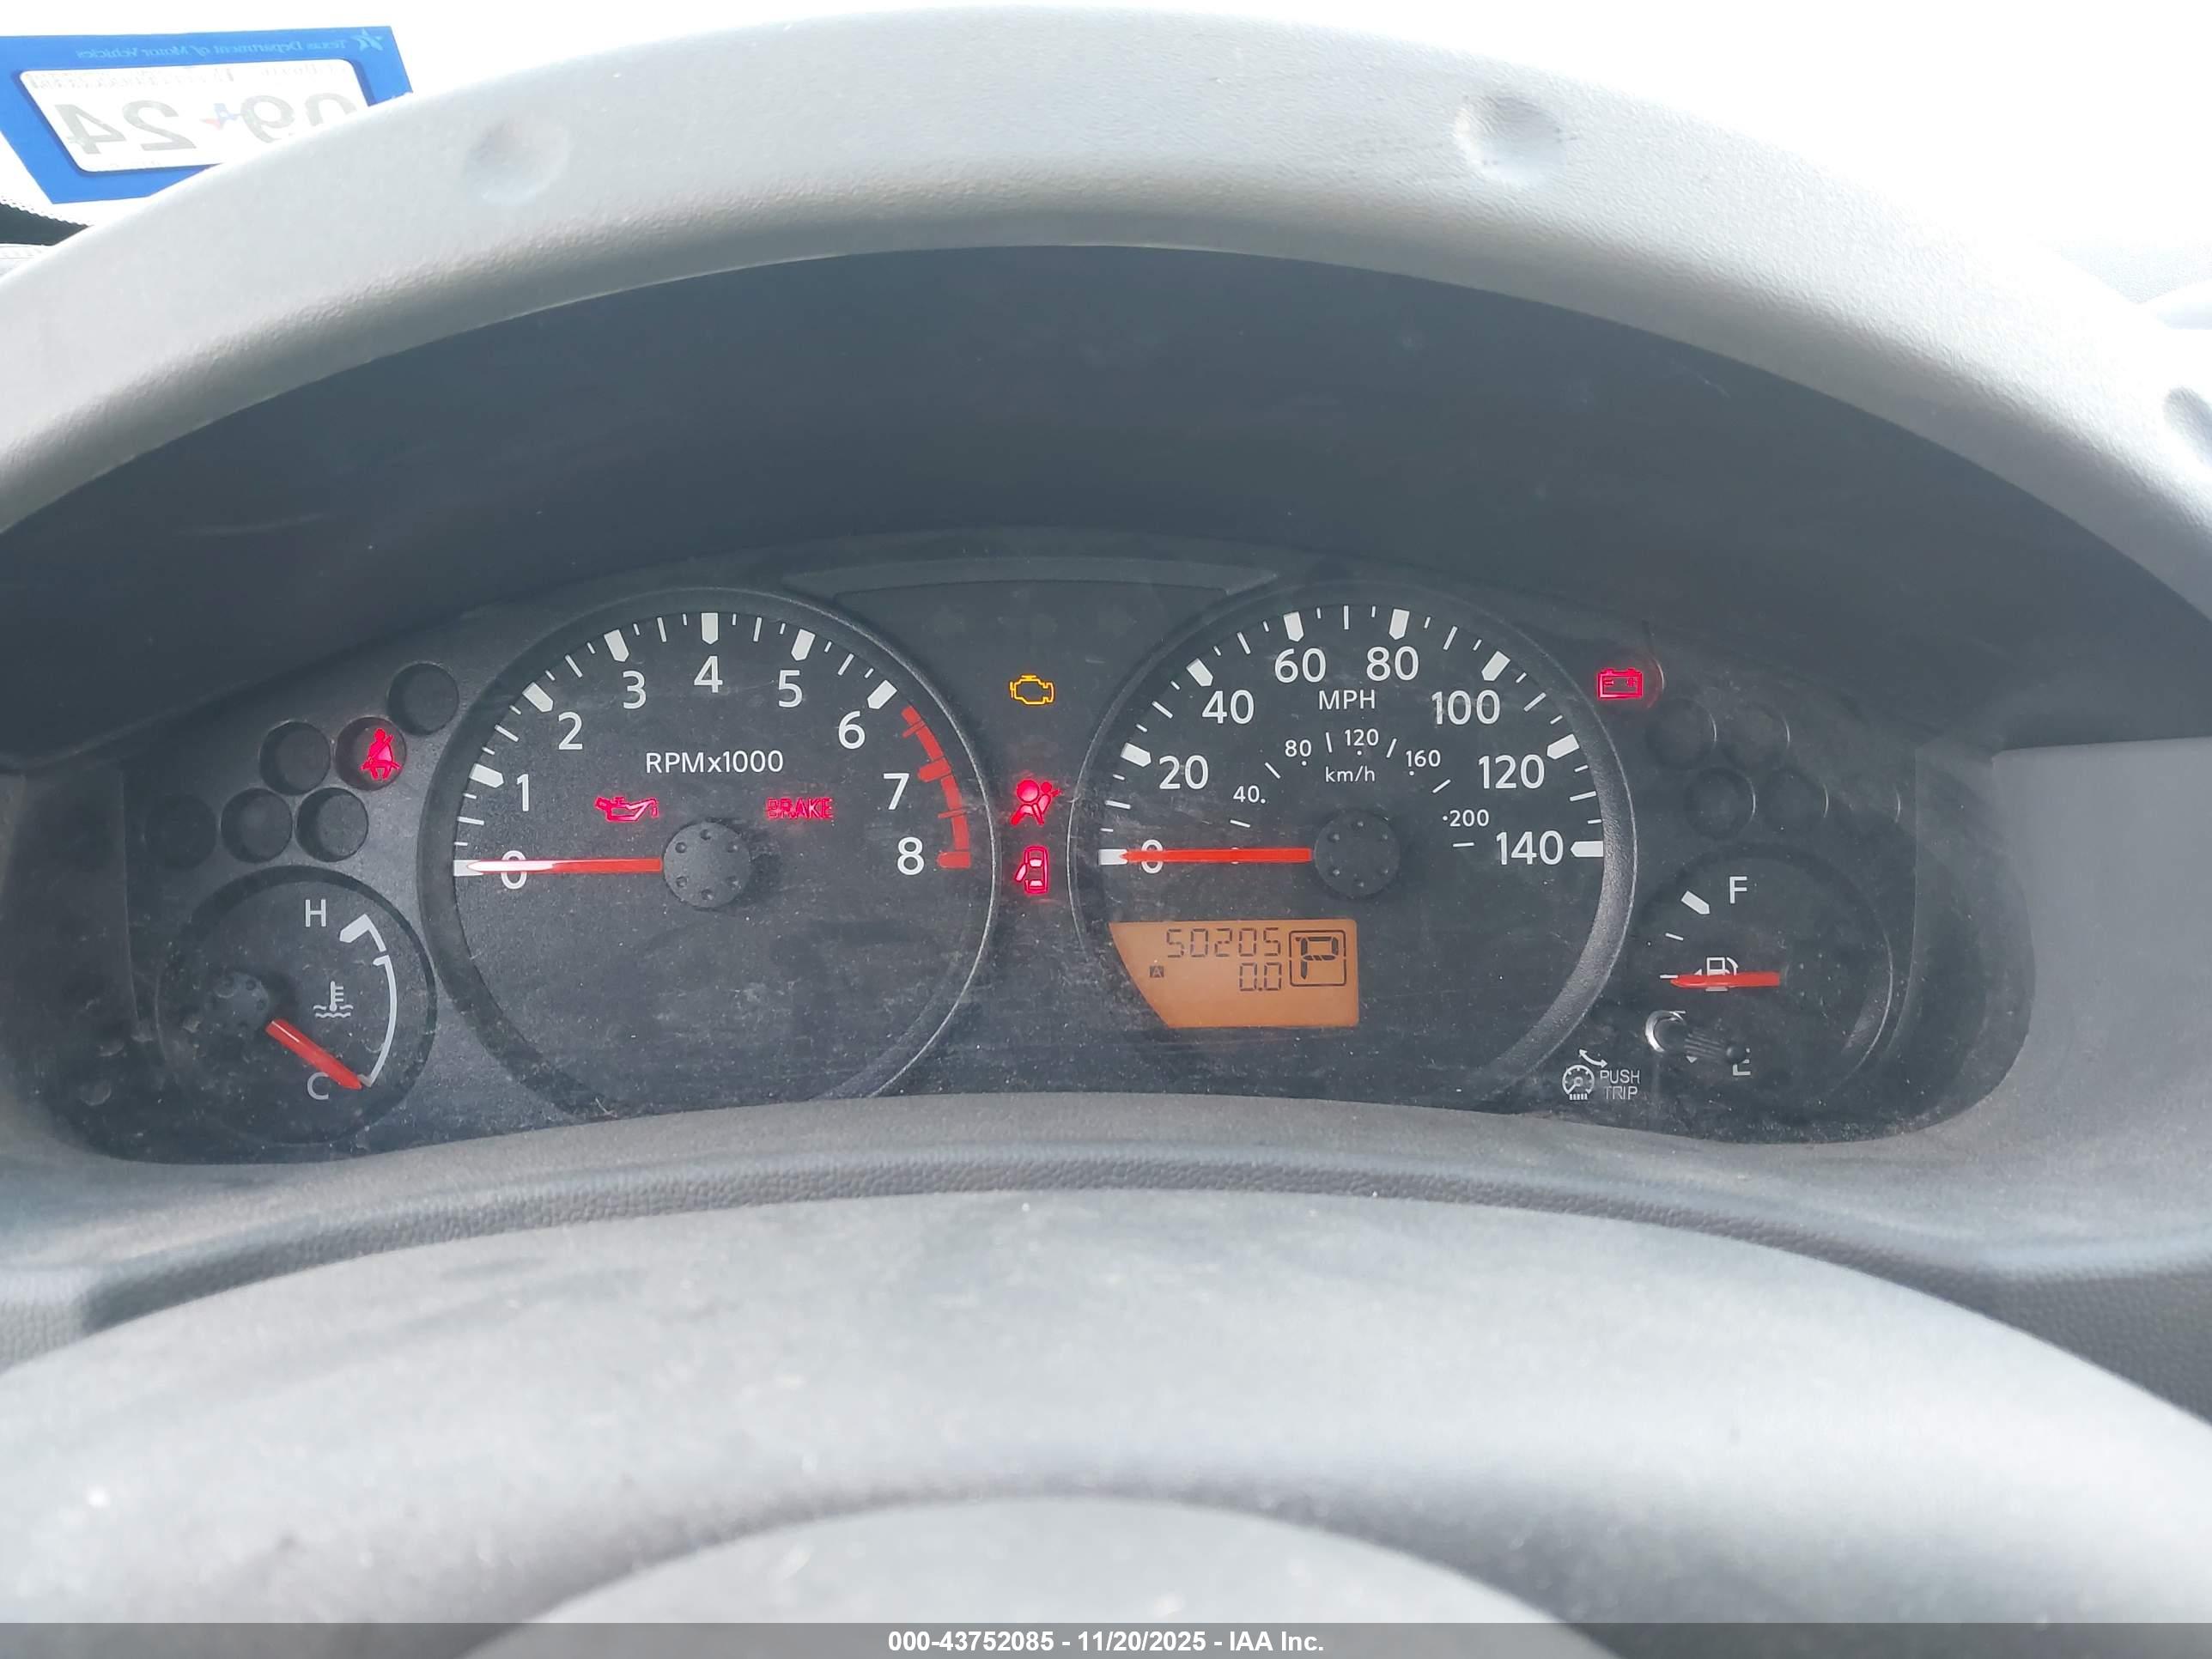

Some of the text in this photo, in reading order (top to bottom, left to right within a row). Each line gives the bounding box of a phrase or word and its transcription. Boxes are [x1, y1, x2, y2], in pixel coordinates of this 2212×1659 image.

[694, 655, 723, 693] 4
[1274, 647, 1327, 683] 60
[1366, 647, 1419, 681] 80
[622, 671, 646, 709] 3
[778, 670, 803, 708] 5
[1318, 690, 1375, 710] MPH
[1202, 690, 1255, 724] 40
[1431, 690, 1500, 725] 100
[558, 712, 583, 750] 2
[838, 711, 866, 749] 6
[1345, 729, 1379, 746] 120
[646, 750, 783, 774] RPMx1000
[1285, 739, 1312, 757] 80
[1406, 750, 1441, 767] 160
[1159, 755, 1209, 789] 20
[1325, 766, 1375, 782] km/h
[1478, 754, 1545, 789] 120
[516, 774, 529, 811] 1
[767, 797, 833, 819] BRAKE
[883, 773, 909, 811] 7
[1233, 786, 1260, 802] 40
[1449, 810, 1489, 827] 200
[897, 837, 925, 875] 8
[1140, 839, 1164, 874] 0
[1496, 830, 1564, 866] 140
[501, 850, 527, 890] 0
[1729, 876, 1748, 904] F
[304, 899, 326, 927] H
[1166, 927, 1281, 958] 50205
[1295, 936, 1340, 981] P
[1239, 962, 1282, 992] 0.0
[307, 1072, 329, 1100] C
[1600, 1069, 1640, 1084] PUSH
[1604, 1086, 1638, 1100] TRIP
